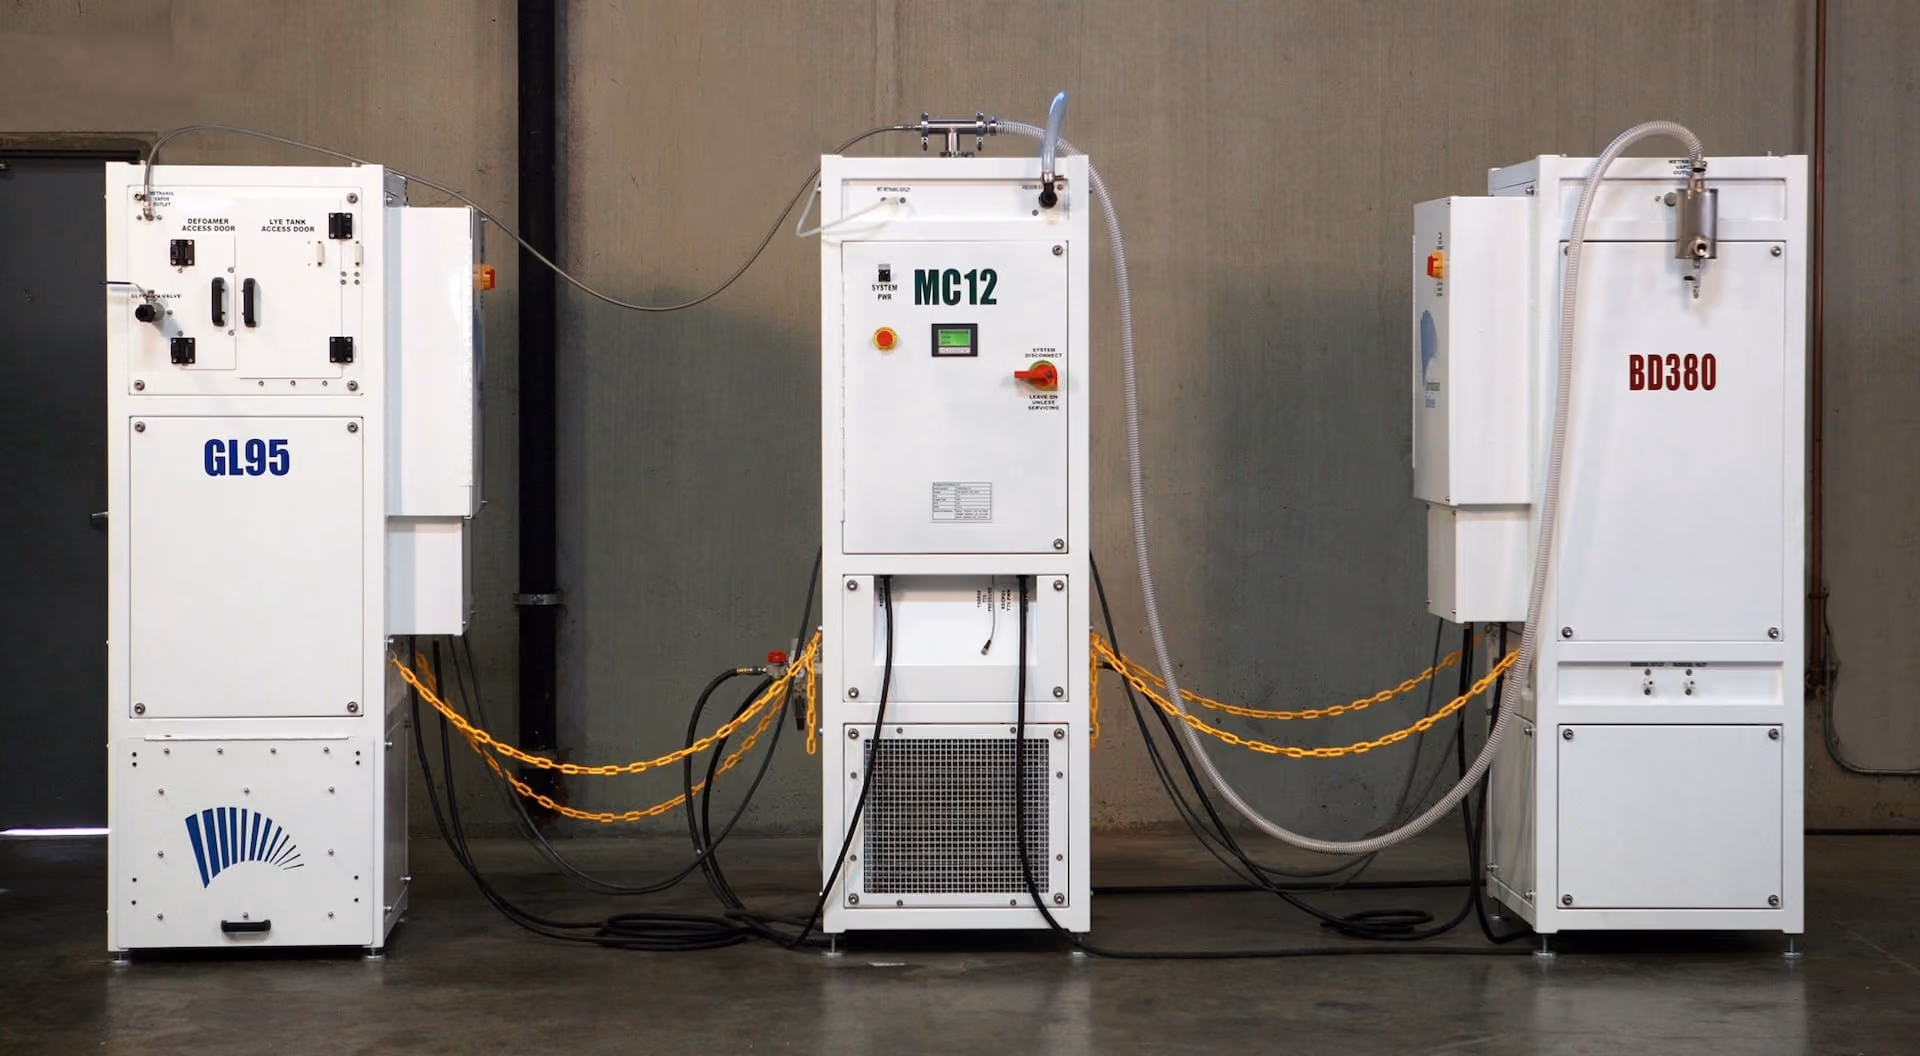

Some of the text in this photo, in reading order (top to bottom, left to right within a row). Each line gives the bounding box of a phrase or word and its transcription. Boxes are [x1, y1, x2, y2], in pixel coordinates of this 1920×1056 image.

[872, 284, 898, 292] SYSTEM
[914, 268, 998, 306] MC12
[1629, 353, 1716, 391] BD380
[204, 439, 290, 476] GL95
